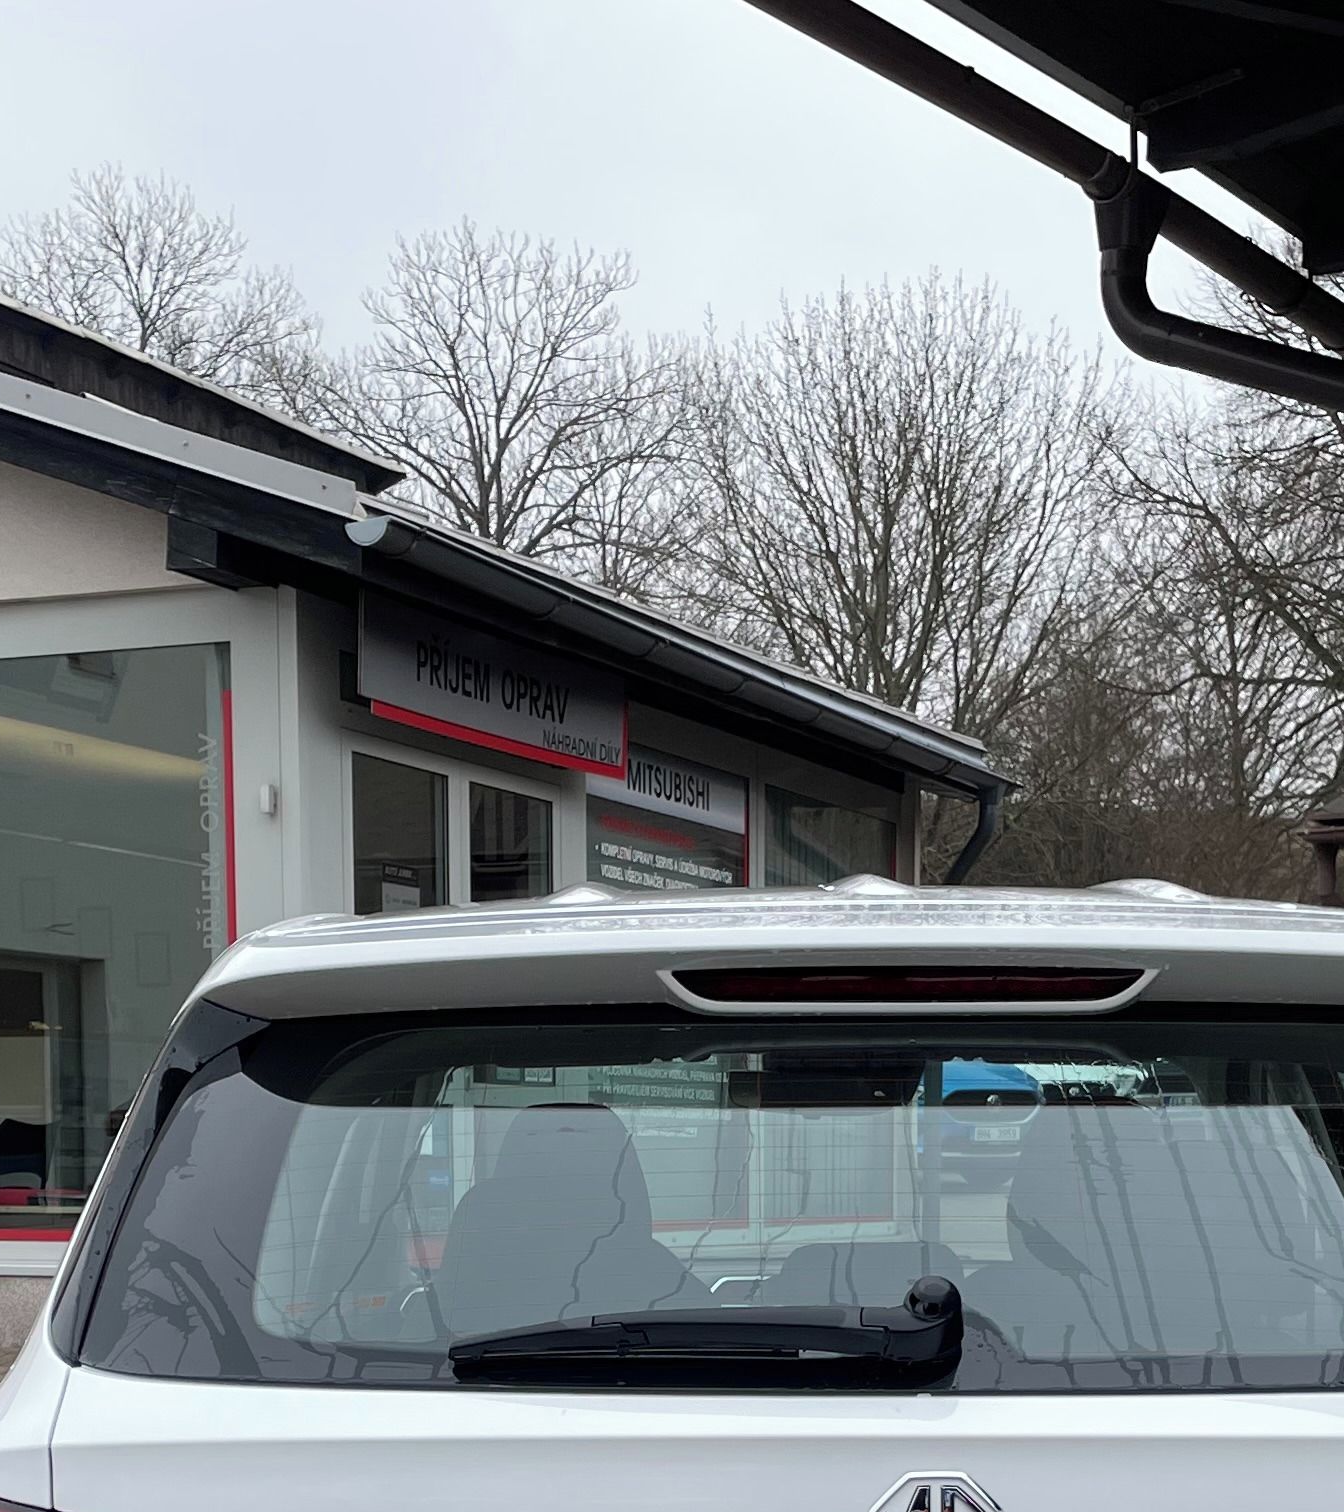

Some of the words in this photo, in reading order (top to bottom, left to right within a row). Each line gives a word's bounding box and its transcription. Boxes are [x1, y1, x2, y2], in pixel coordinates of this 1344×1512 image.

[415, 634, 491, 705] PŘÍJEM
[501, 669, 570, 725] OPRAV
[542, 726, 598, 760] NÁHRADNÍ
[599, 740, 623, 766] DÍLY
[198, 732, 219, 833] OPRAV
[626, 758, 711, 812] MITSUBISHI
